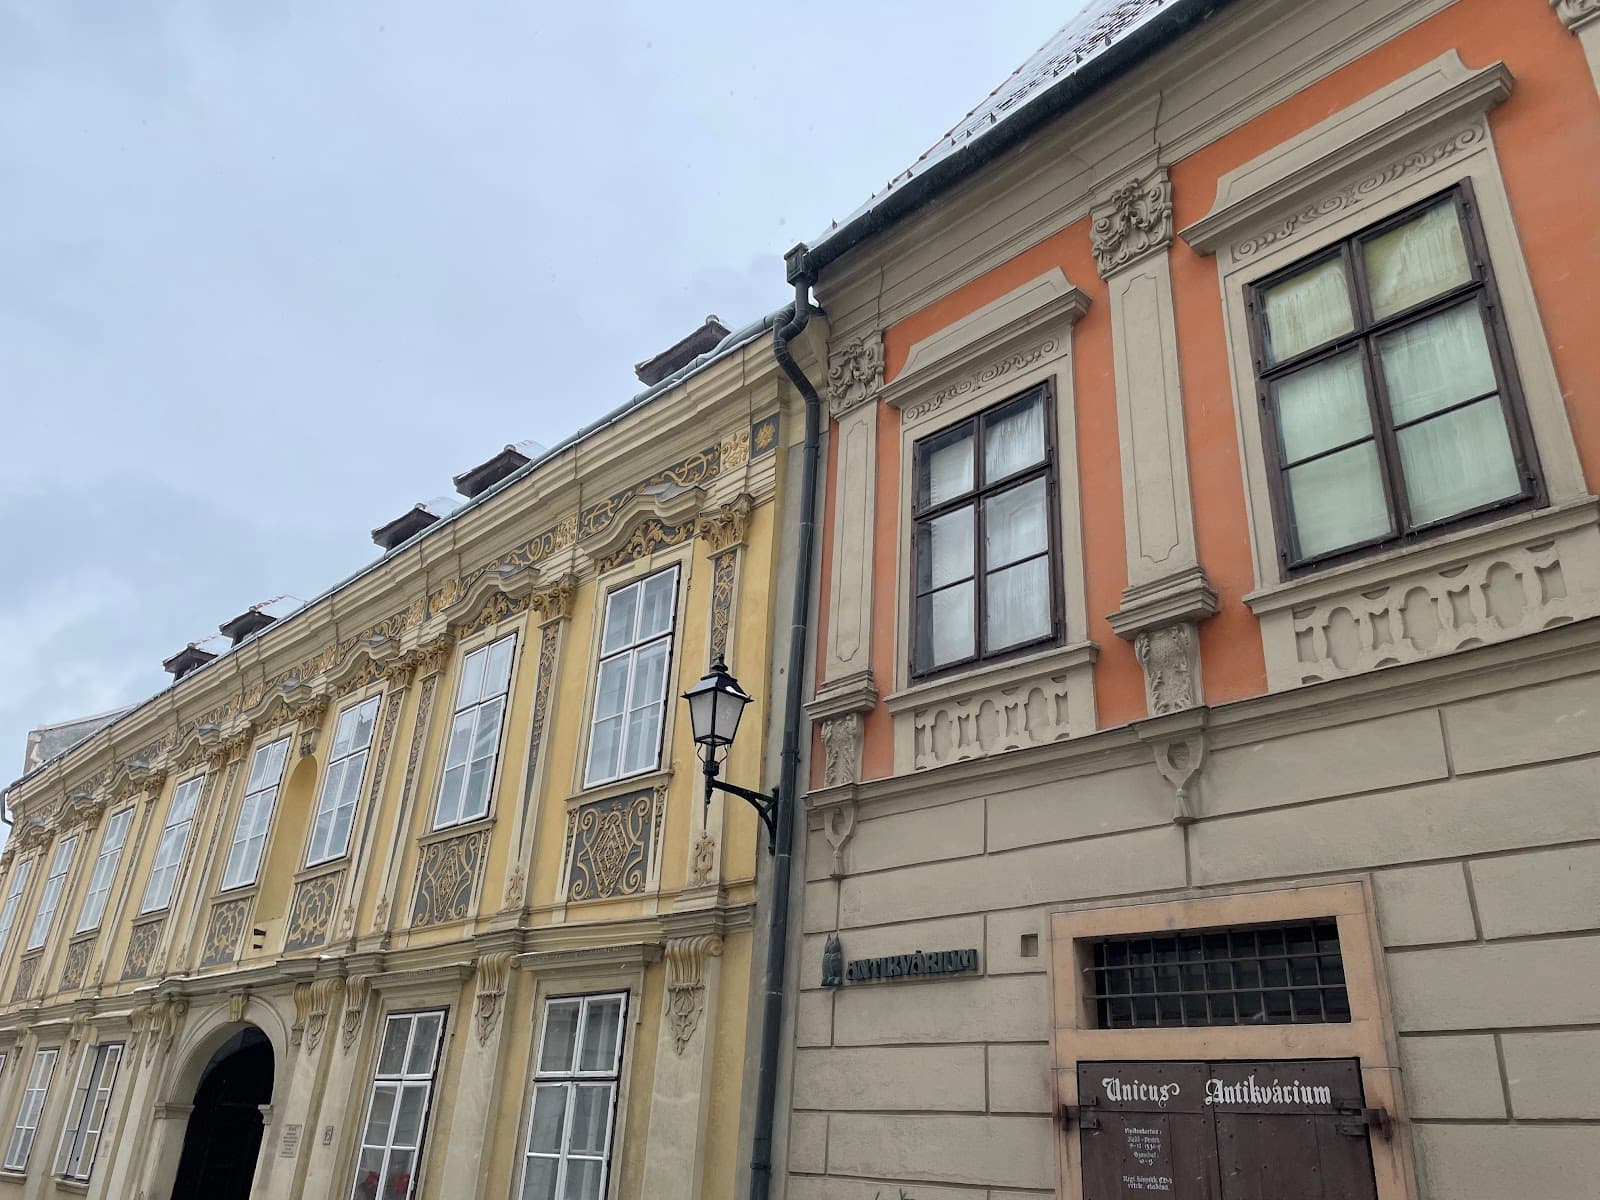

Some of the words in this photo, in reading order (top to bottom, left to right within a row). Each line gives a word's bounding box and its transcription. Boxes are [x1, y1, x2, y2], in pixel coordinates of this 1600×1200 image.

[846, 949, 977, 980] ANTIKVÁRIUM
[1102, 1077, 1180, 1108] Unicus
[1205, 1075, 1332, 1105] Antikvárium
